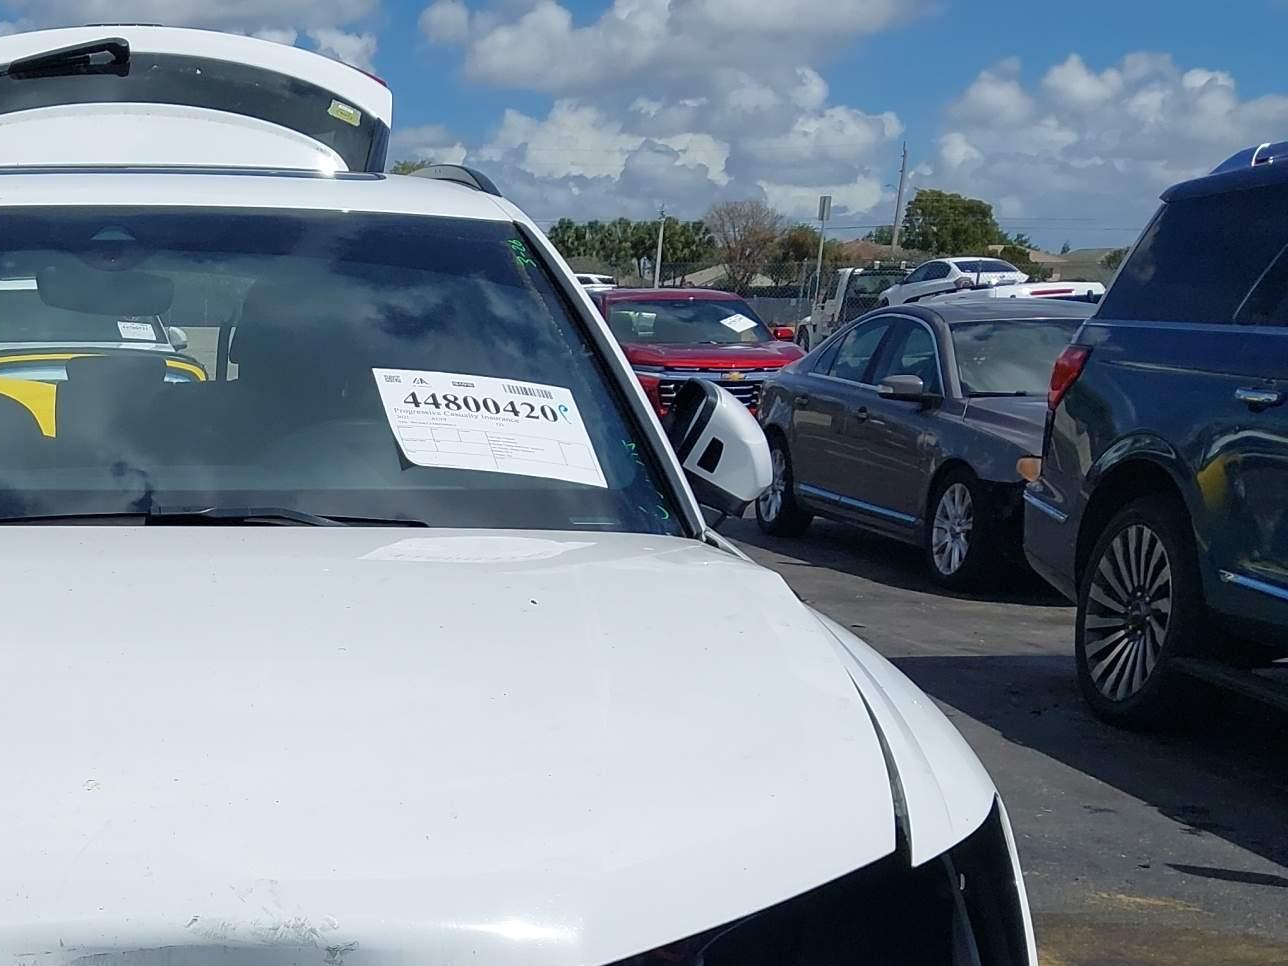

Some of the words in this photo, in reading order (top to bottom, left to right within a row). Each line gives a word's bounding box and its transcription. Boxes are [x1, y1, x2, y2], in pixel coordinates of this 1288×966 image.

[394, 407, 441, 418] Progressive
[481, 414, 520, 424] Insurance
[403, 391, 558, 423] 44800420
